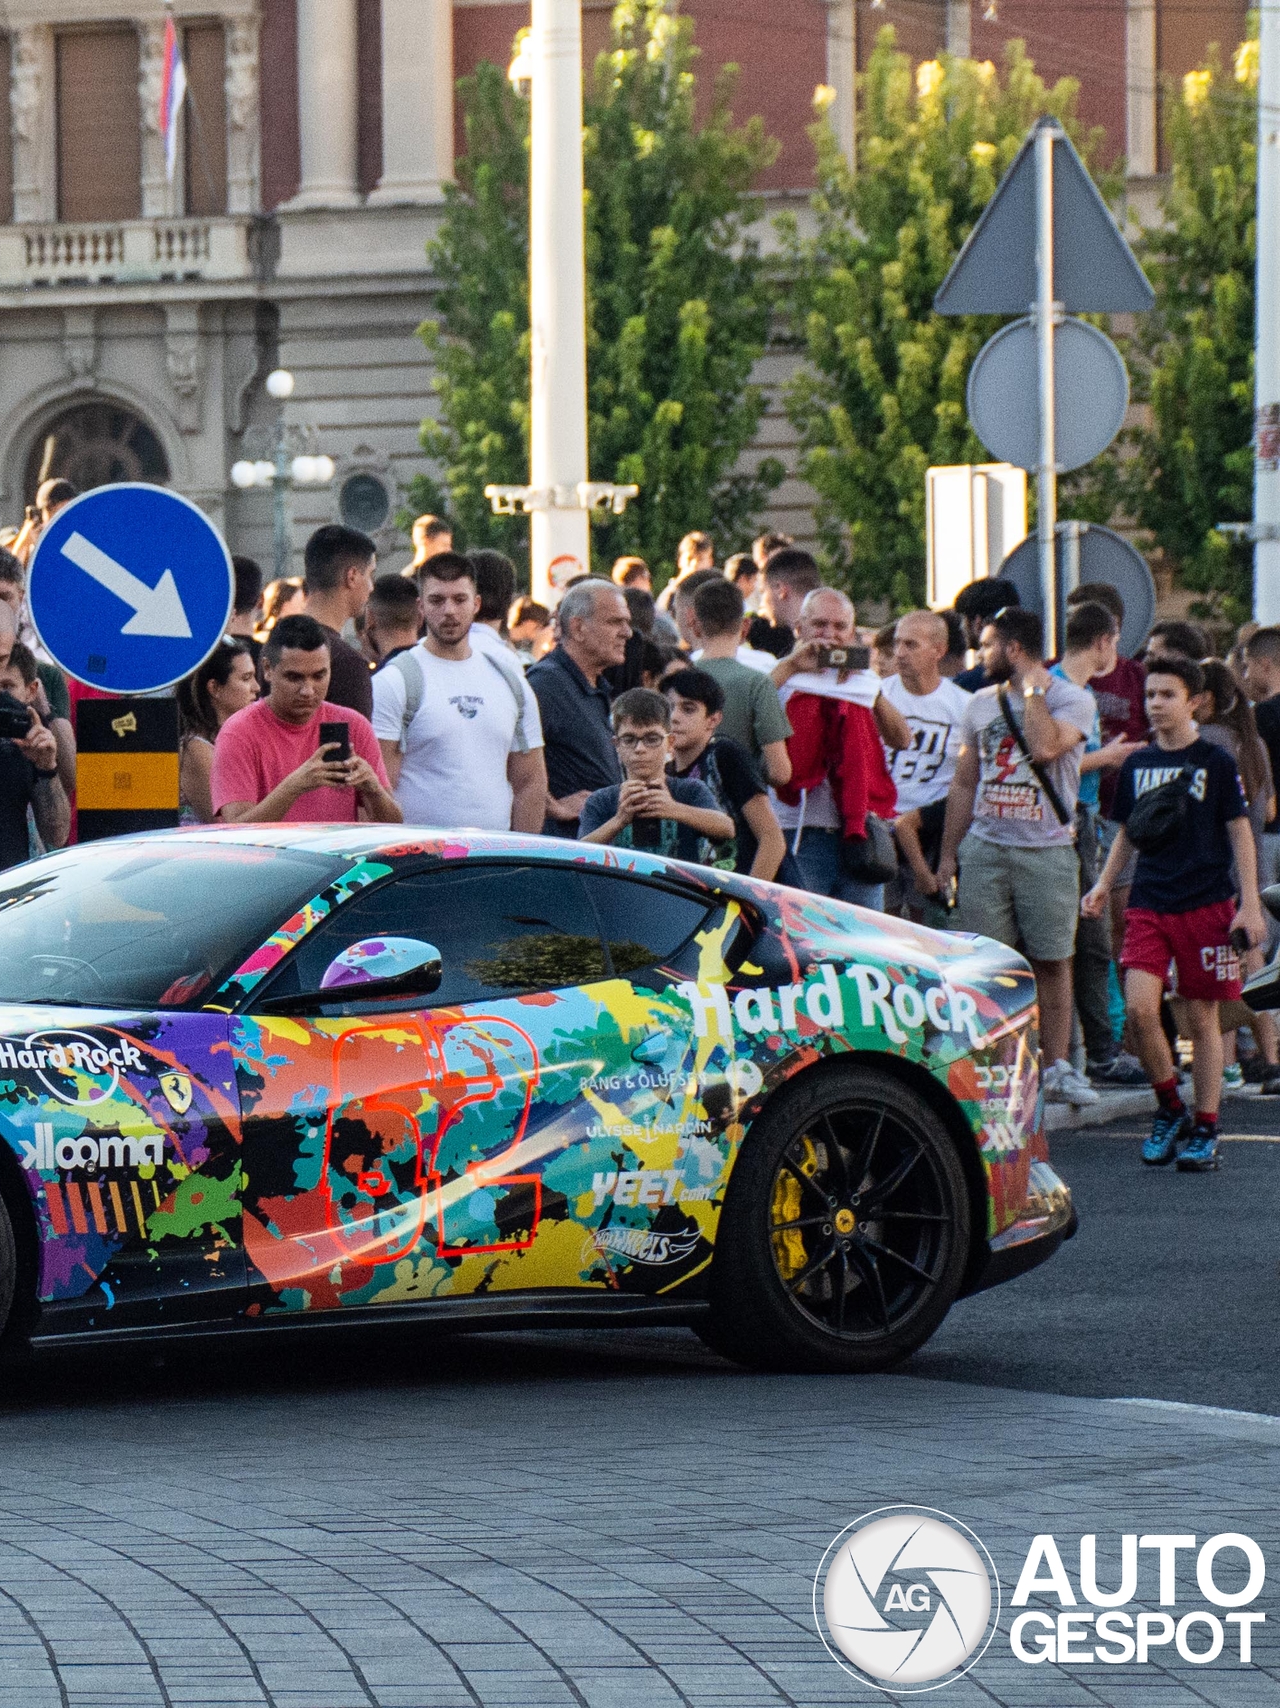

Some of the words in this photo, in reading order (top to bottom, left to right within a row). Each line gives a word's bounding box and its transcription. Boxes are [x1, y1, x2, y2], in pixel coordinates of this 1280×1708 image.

[676, 963, 845, 1038] Hard
[845, 963, 988, 1050] Rock
[68, 1038, 147, 1074] Rock
[580, 1075, 621, 1091] BANG
[625, 1074, 636, 1089] &
[586, 1123, 643, 1138] ULYSSE
[653, 1120, 713, 1136] NARDIN
